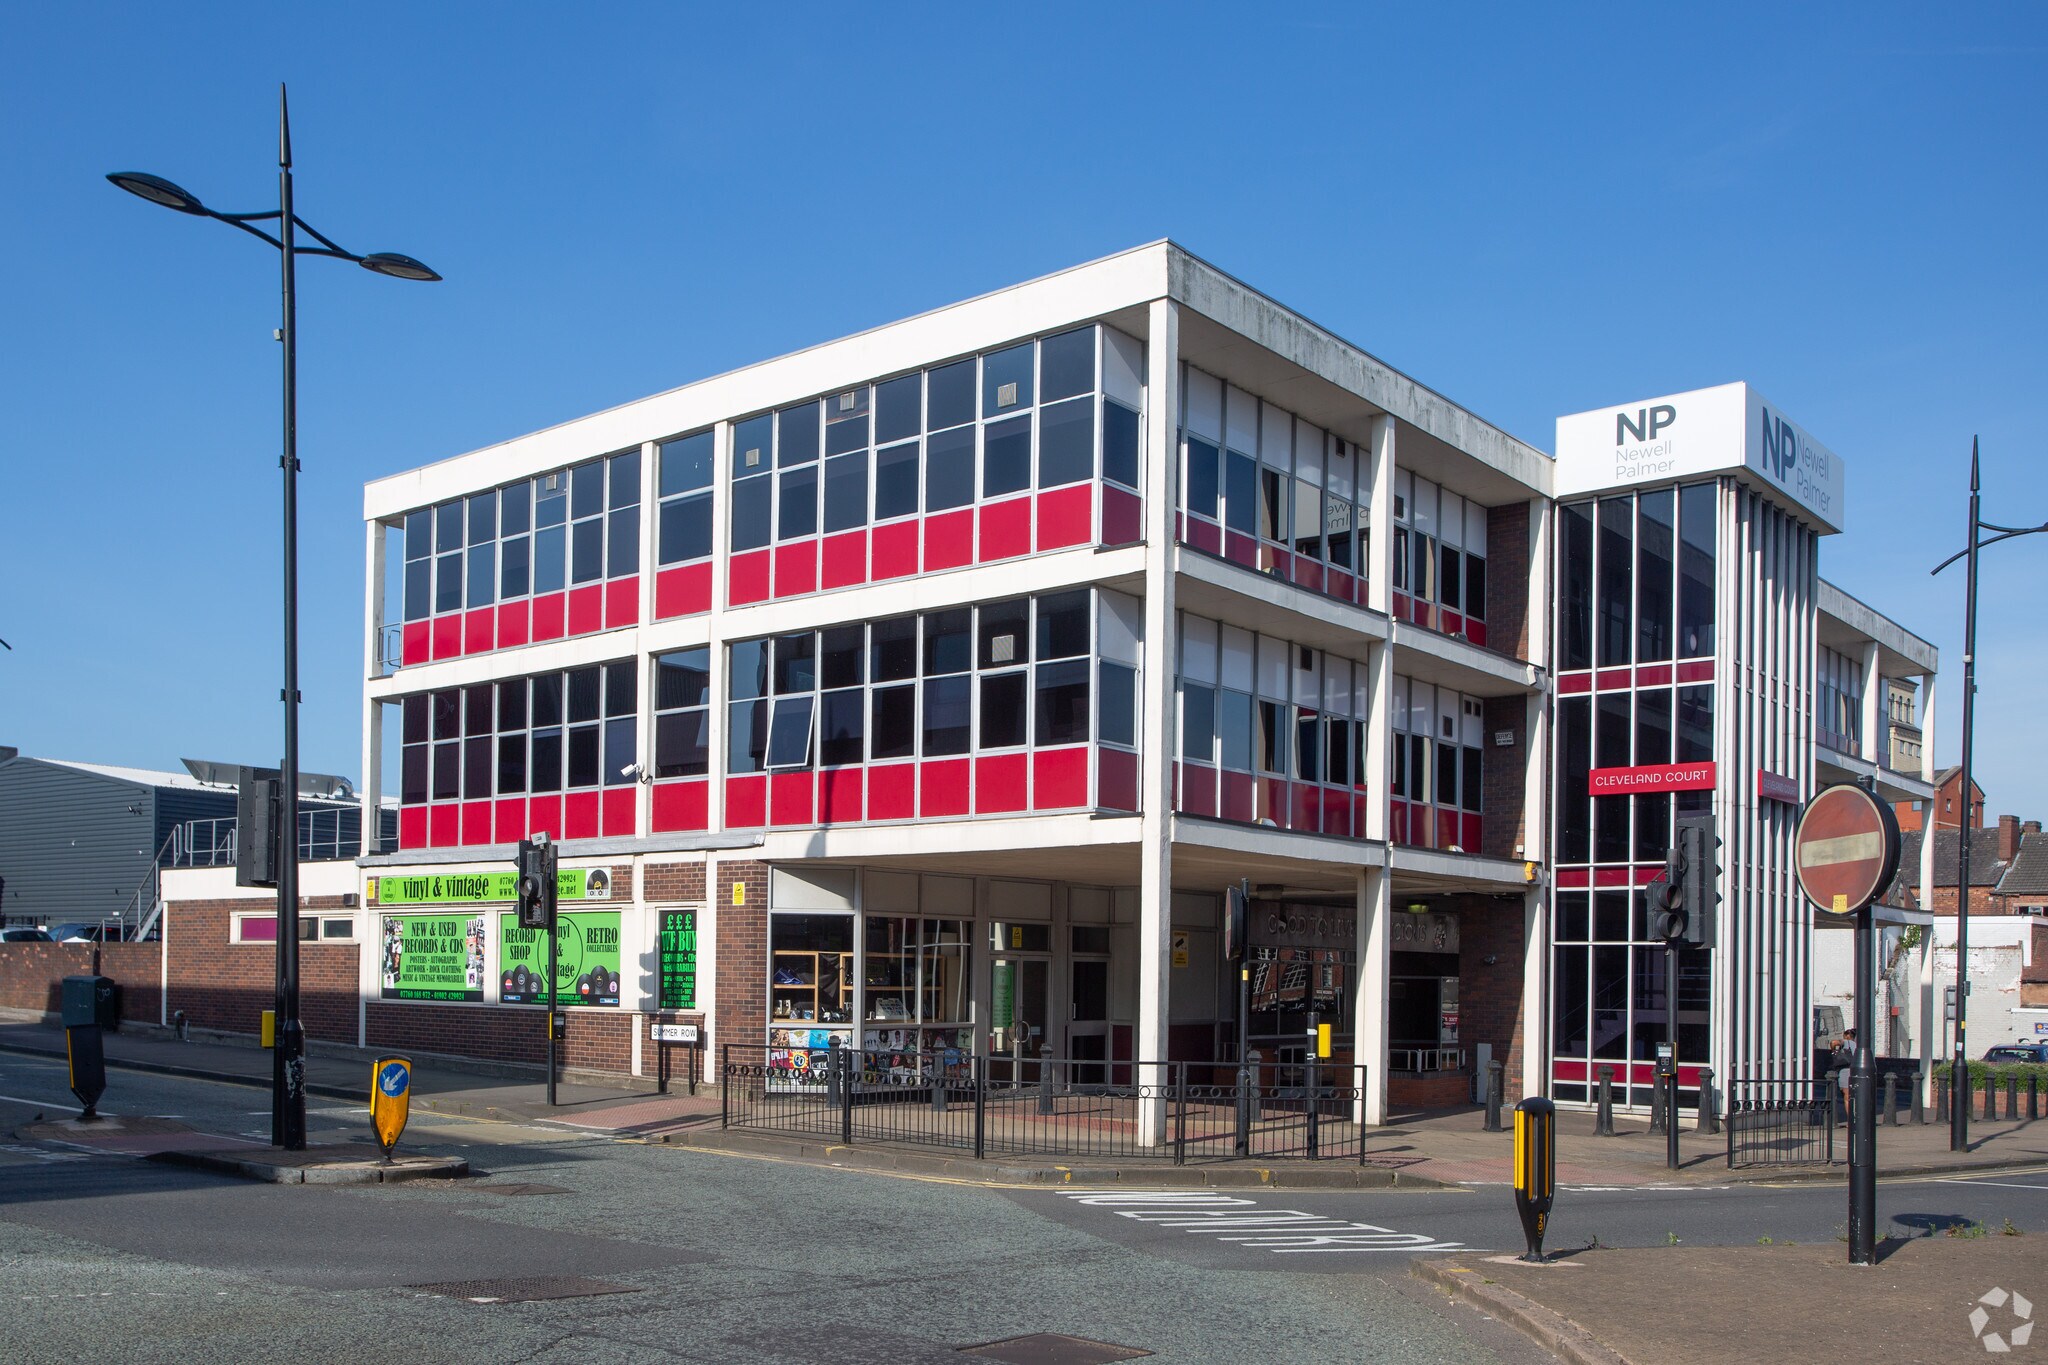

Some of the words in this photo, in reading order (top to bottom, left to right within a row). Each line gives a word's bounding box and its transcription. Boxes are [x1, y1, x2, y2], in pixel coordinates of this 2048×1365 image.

[1617, 405, 1676, 446] NP
[1616, 440, 1672, 463] Newell
[1762, 406, 1796, 484] NP
[1797, 434, 1829, 481] Newell
[1616, 460, 1675, 480] Palmer
[1797, 467, 1831, 514] Palmer
[1595, 773, 1662, 786] CLEVELAND
[1665, 770, 1708, 782] COURT
[403, 878, 429, 900] vinyl
[433, 877, 442, 897] &
[446, 875, 489, 899] vintage
[411, 922, 427, 937] NEW
[430, 922, 436, 937] &
[438, 921, 457, 937] USED
[667, 914, 674, 930] £
[676, 914, 683, 930] £
[685, 914, 692, 930] £
[505, 928, 536, 943] RECORD
[557, 924, 570, 939] nyl
[586, 927, 618, 943] RETRO
[404, 938, 438, 954] RECORDS
[440, 939, 447, 954] &
[449, 939, 464, 954] CDS
[586, 944, 618, 953] COLLECTABLES
[661, 931, 676, 951] WE
[678, 931, 697, 951] BUY
[410, 956, 427, 964] POSTERS
[431, 956, 457, 964] AUTOGRAPHS
[510, 945, 531, 960] SHOP
[406, 965, 426, 973] ARTWORK
[429, 965, 440, 973] ROCK
[402, 974, 414, 982] MUSIC
[419, 974, 435, 982] VINTAGE
[436, 975, 464, 983] MEMORABILIA
[653, 1028, 678, 1037] SUMMER
[681, 1029, 696, 1037] ROW
